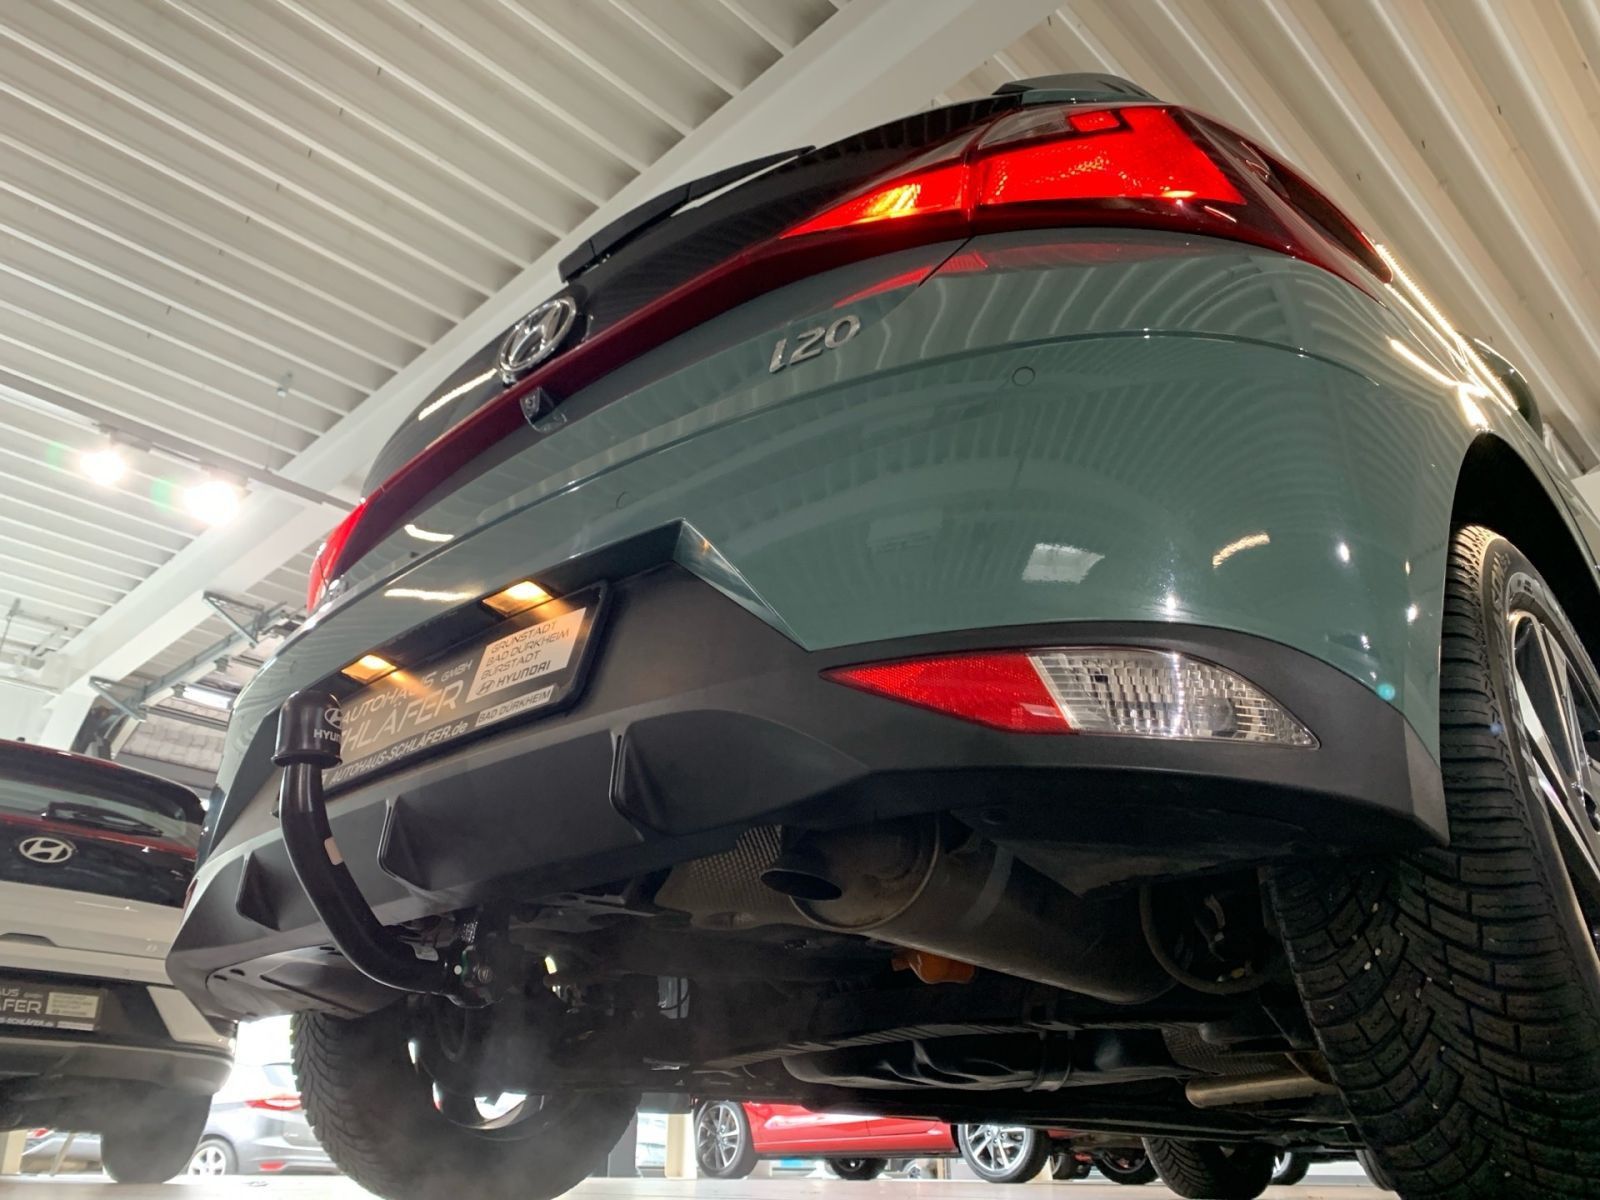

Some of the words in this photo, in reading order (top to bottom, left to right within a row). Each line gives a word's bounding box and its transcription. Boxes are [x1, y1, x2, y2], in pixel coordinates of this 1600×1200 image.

[486, 651, 510, 667] BAD
[496, 660, 552, 687] HYUNDAI
[480, 709, 498, 720] BAD
[0, 998, 42, 1015] FER
